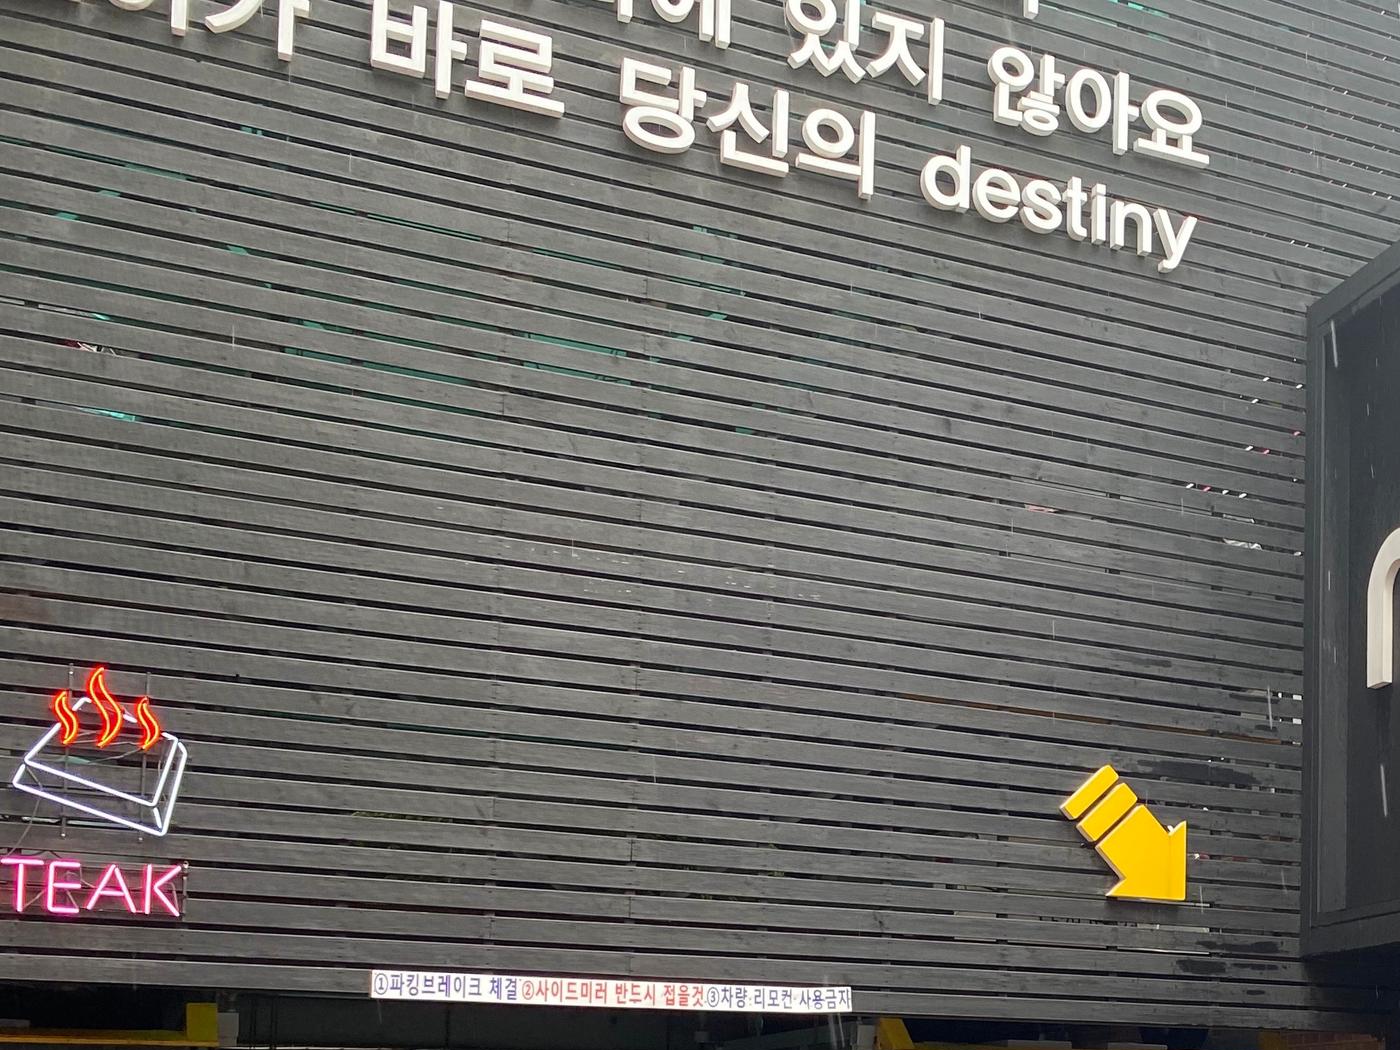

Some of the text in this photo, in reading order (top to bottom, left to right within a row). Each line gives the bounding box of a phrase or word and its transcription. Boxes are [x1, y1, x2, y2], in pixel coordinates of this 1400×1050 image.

[370, 0, 564, 119] 바로
[619, 57, 875, 200] 당신의
[920, 144, 1197, 273] destiny
[787, 0, 944, 105] 있지
[988, 46, 1210, 168] 않아요
[0, 856, 182, 917] TEAK
[489, 976, 518, 1000] 체결
[754, 987, 793, 1010] 리모컨
